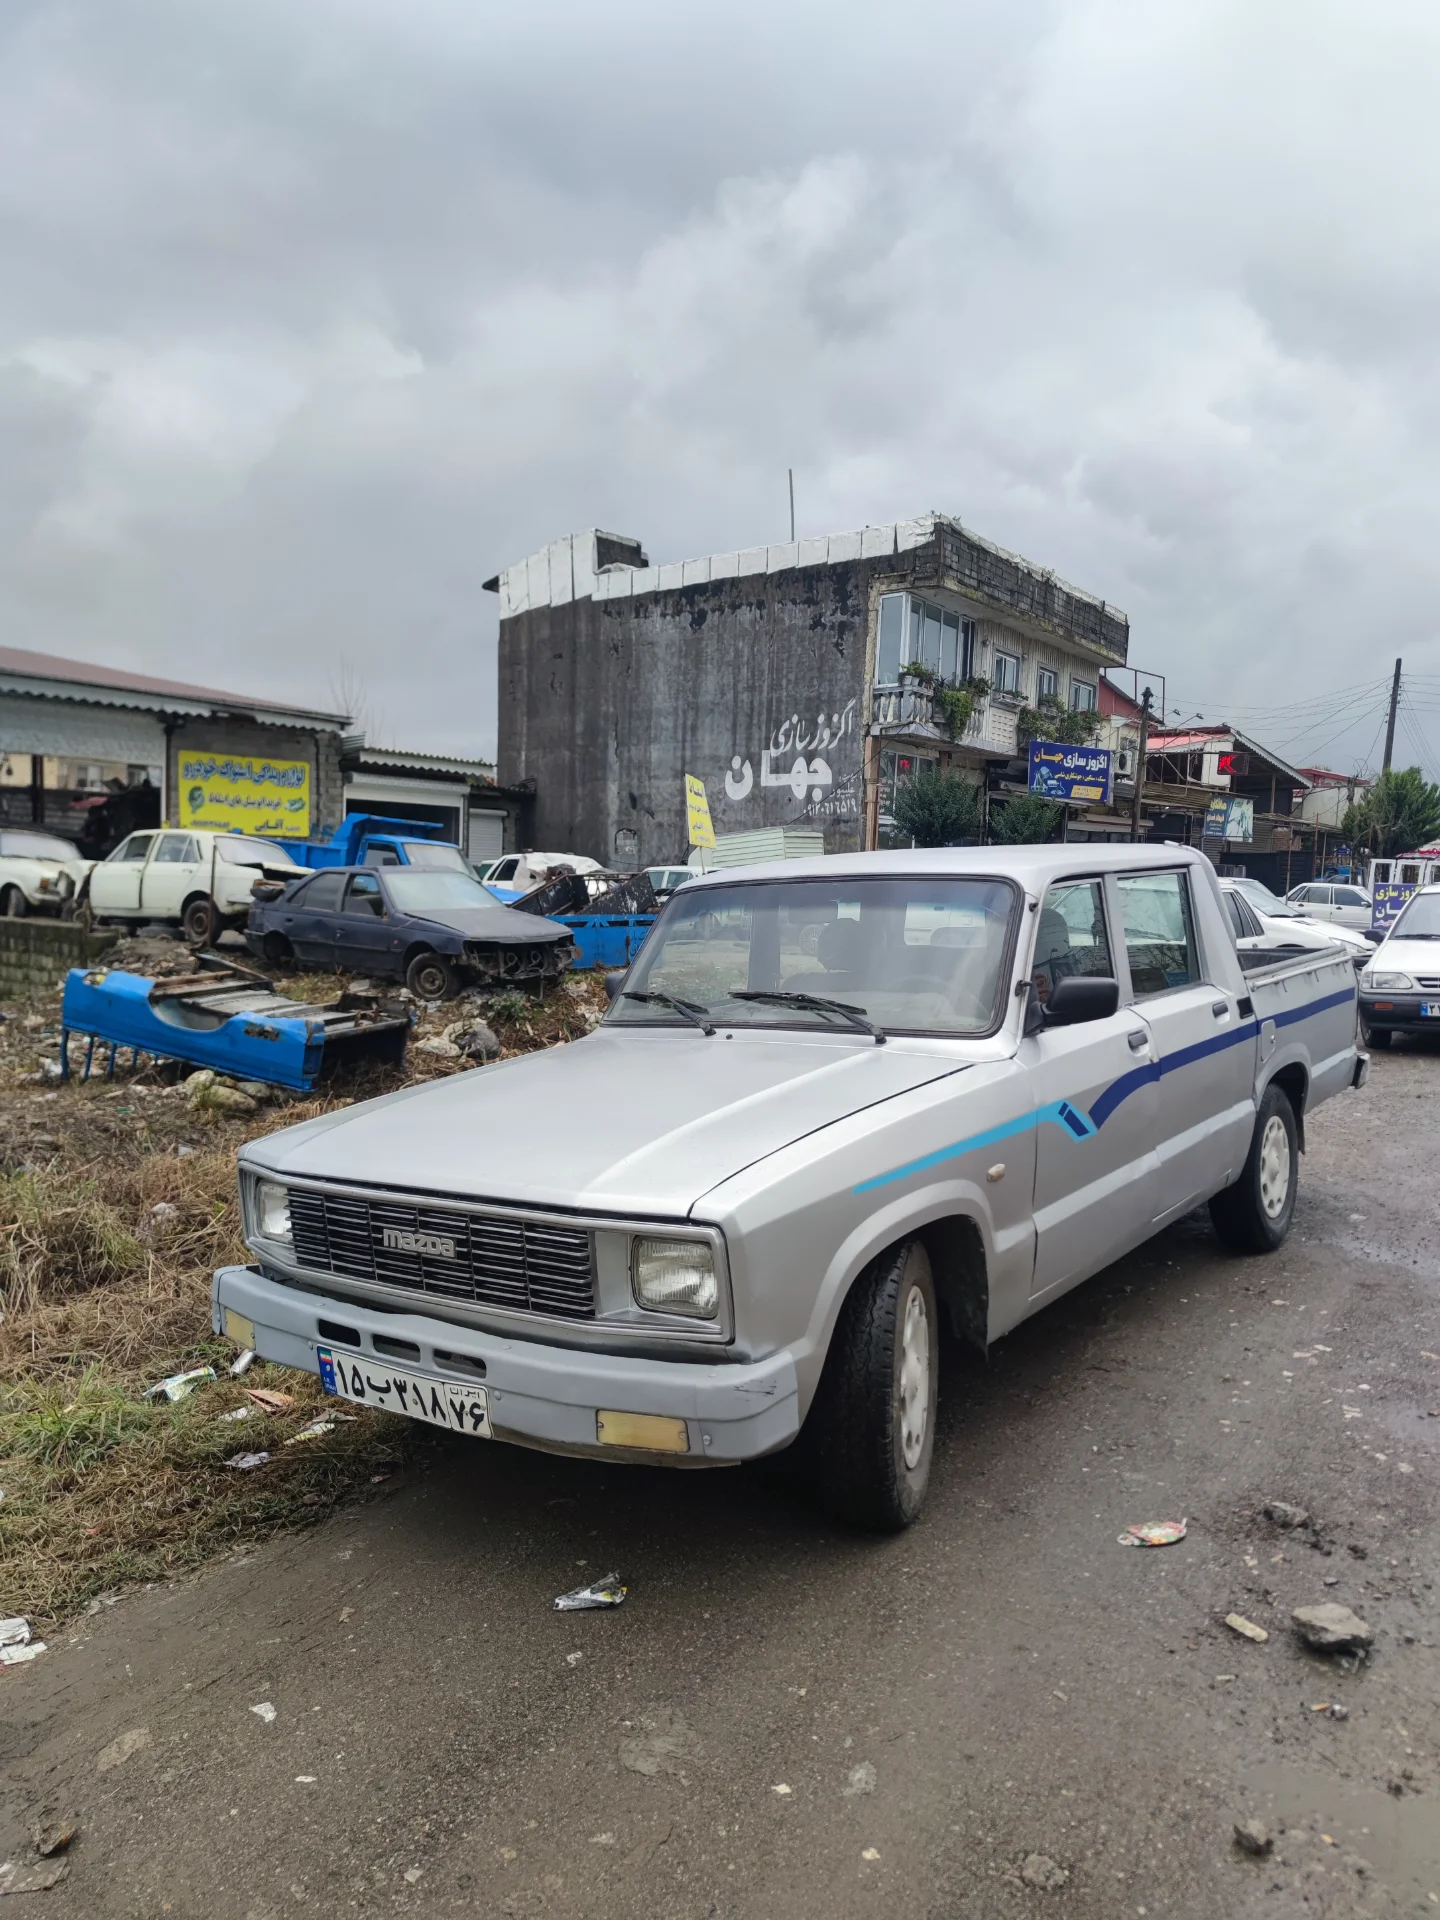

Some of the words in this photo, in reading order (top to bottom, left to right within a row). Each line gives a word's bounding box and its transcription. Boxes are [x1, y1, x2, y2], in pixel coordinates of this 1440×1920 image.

[807, 697, 858, 750] اگزوز
[769, 713, 811, 758] سازی
[1034, 748, 1064, 764] جهان
[1063, 752, 1086, 768] سازی
[1086, 753, 1107, 771] اگزوز
[183, 758, 217, 781] خودرو
[218, 760, 252, 784] استوک
[252, 763, 280, 785] یدکی
[280, 765, 305, 788] لوازم
[725, 750, 832, 801] جهان
[1375, 885, 1398, 901] سازی
[383, 1228, 455, 1258] mazda
[450, 1386, 480, 1399] ایران
[449, 1397, 485, 1431] ۷۶
